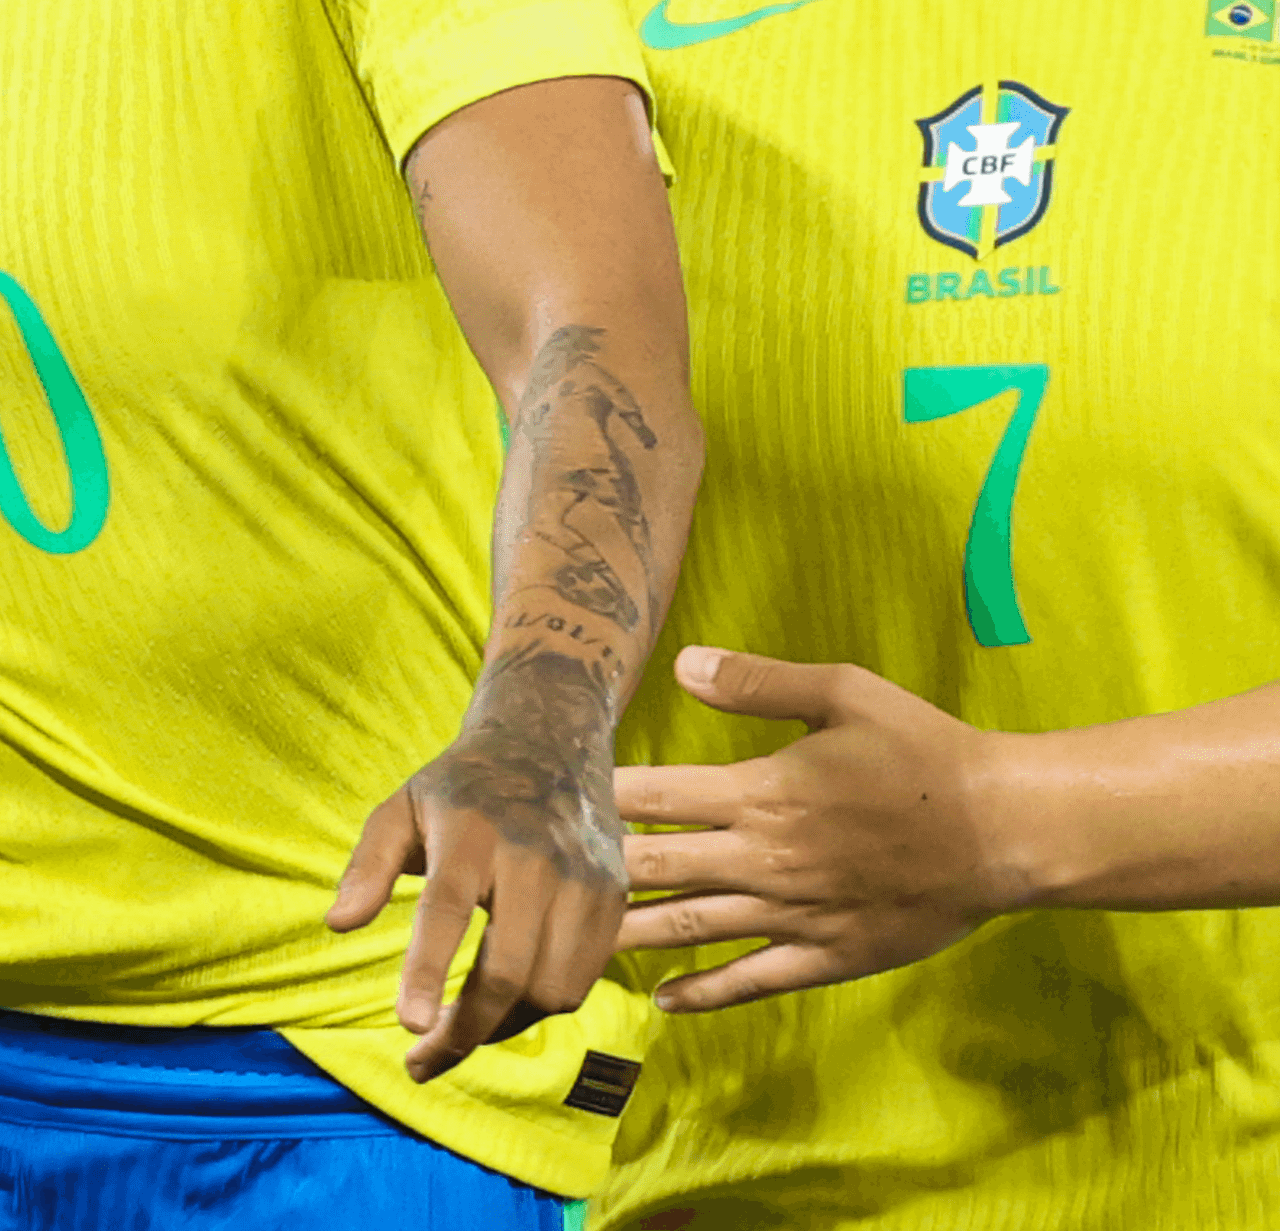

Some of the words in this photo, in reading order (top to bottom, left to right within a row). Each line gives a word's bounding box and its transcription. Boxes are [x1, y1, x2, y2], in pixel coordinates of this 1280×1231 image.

[962, 153, 1016, 175] CBF
[905, 266, 1061, 304] BRASIL
[901, 362, 1051, 649] 7
